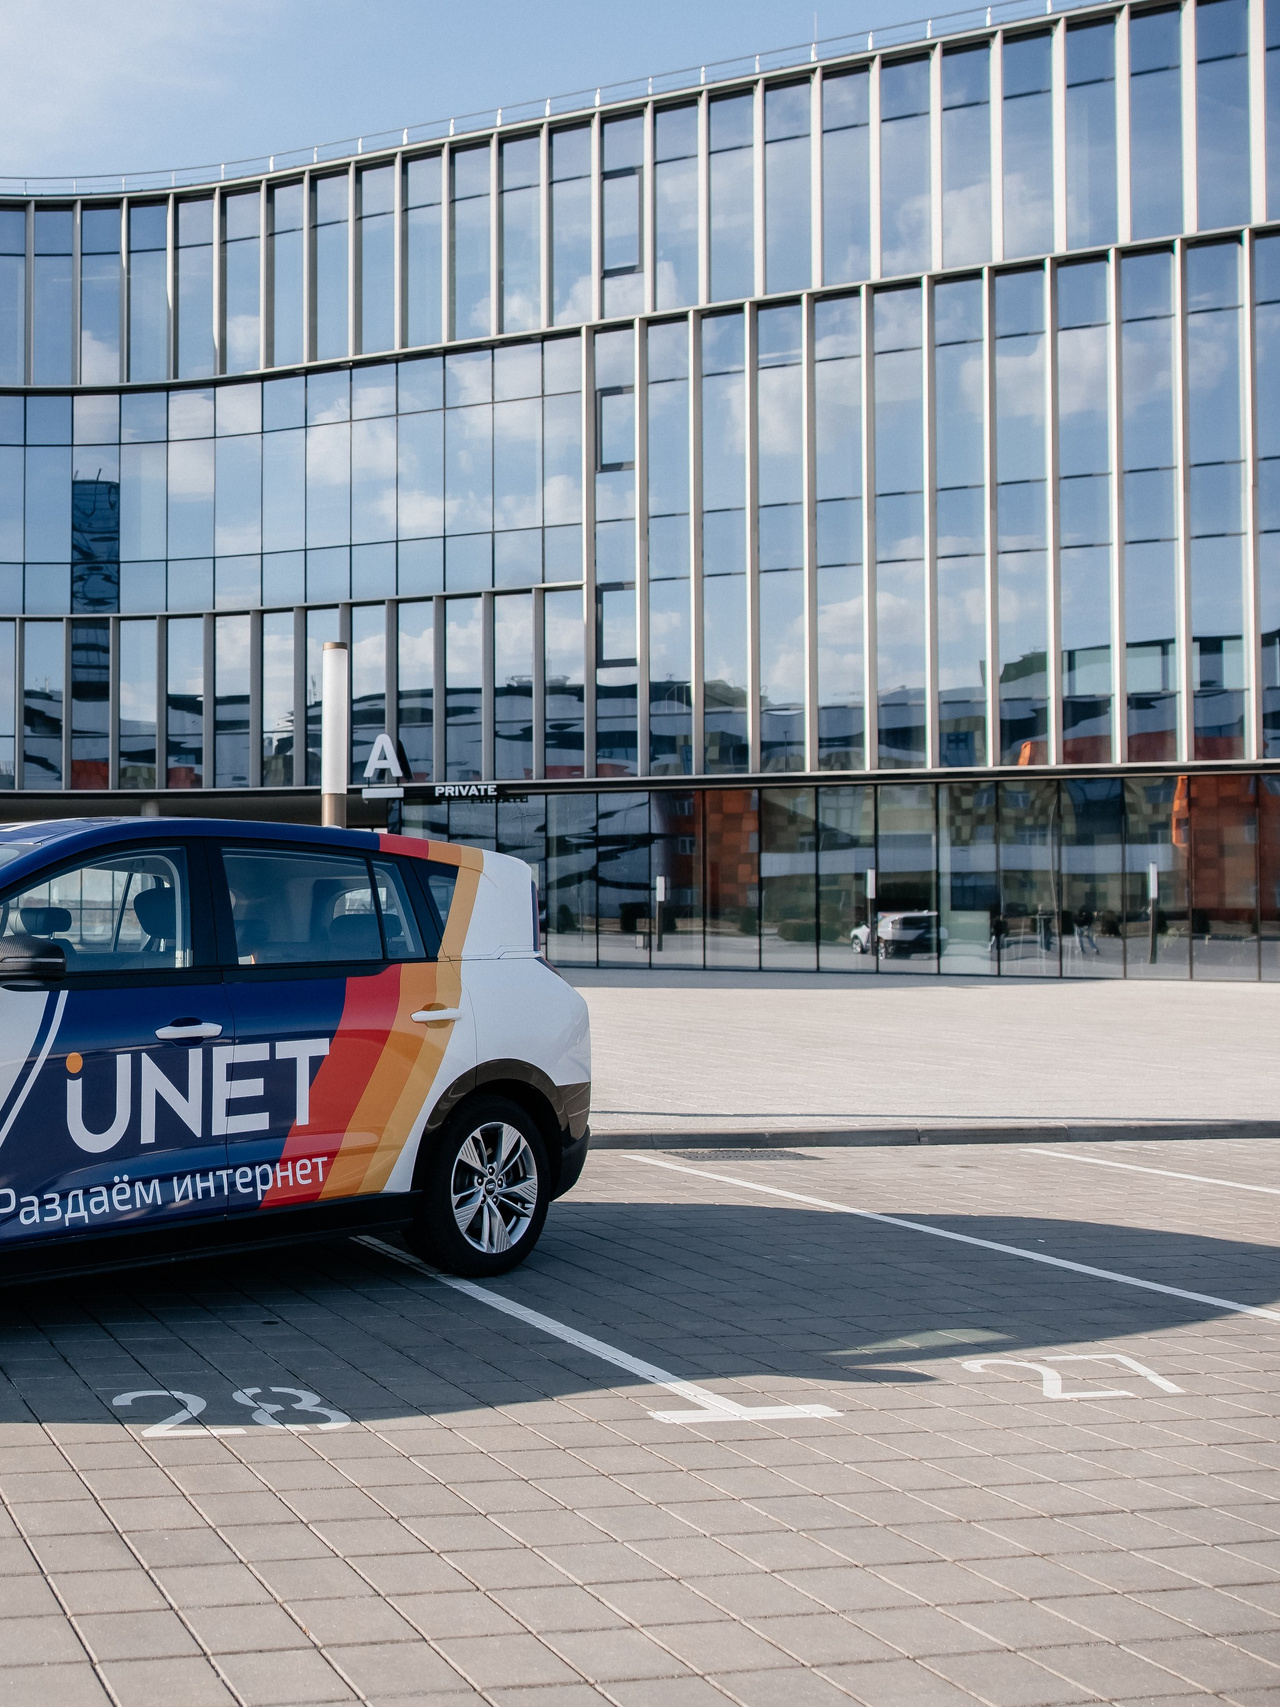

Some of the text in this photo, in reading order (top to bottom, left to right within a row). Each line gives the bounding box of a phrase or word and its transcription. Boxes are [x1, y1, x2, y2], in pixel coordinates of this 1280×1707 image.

[363, 733, 403, 777] A
[435, 784, 497, 797] PRIVATE
[173, 1156, 328, 1203] интернет
[960, 1353, 1187, 1399] 27
[111, 1386, 352, 1438] 28
